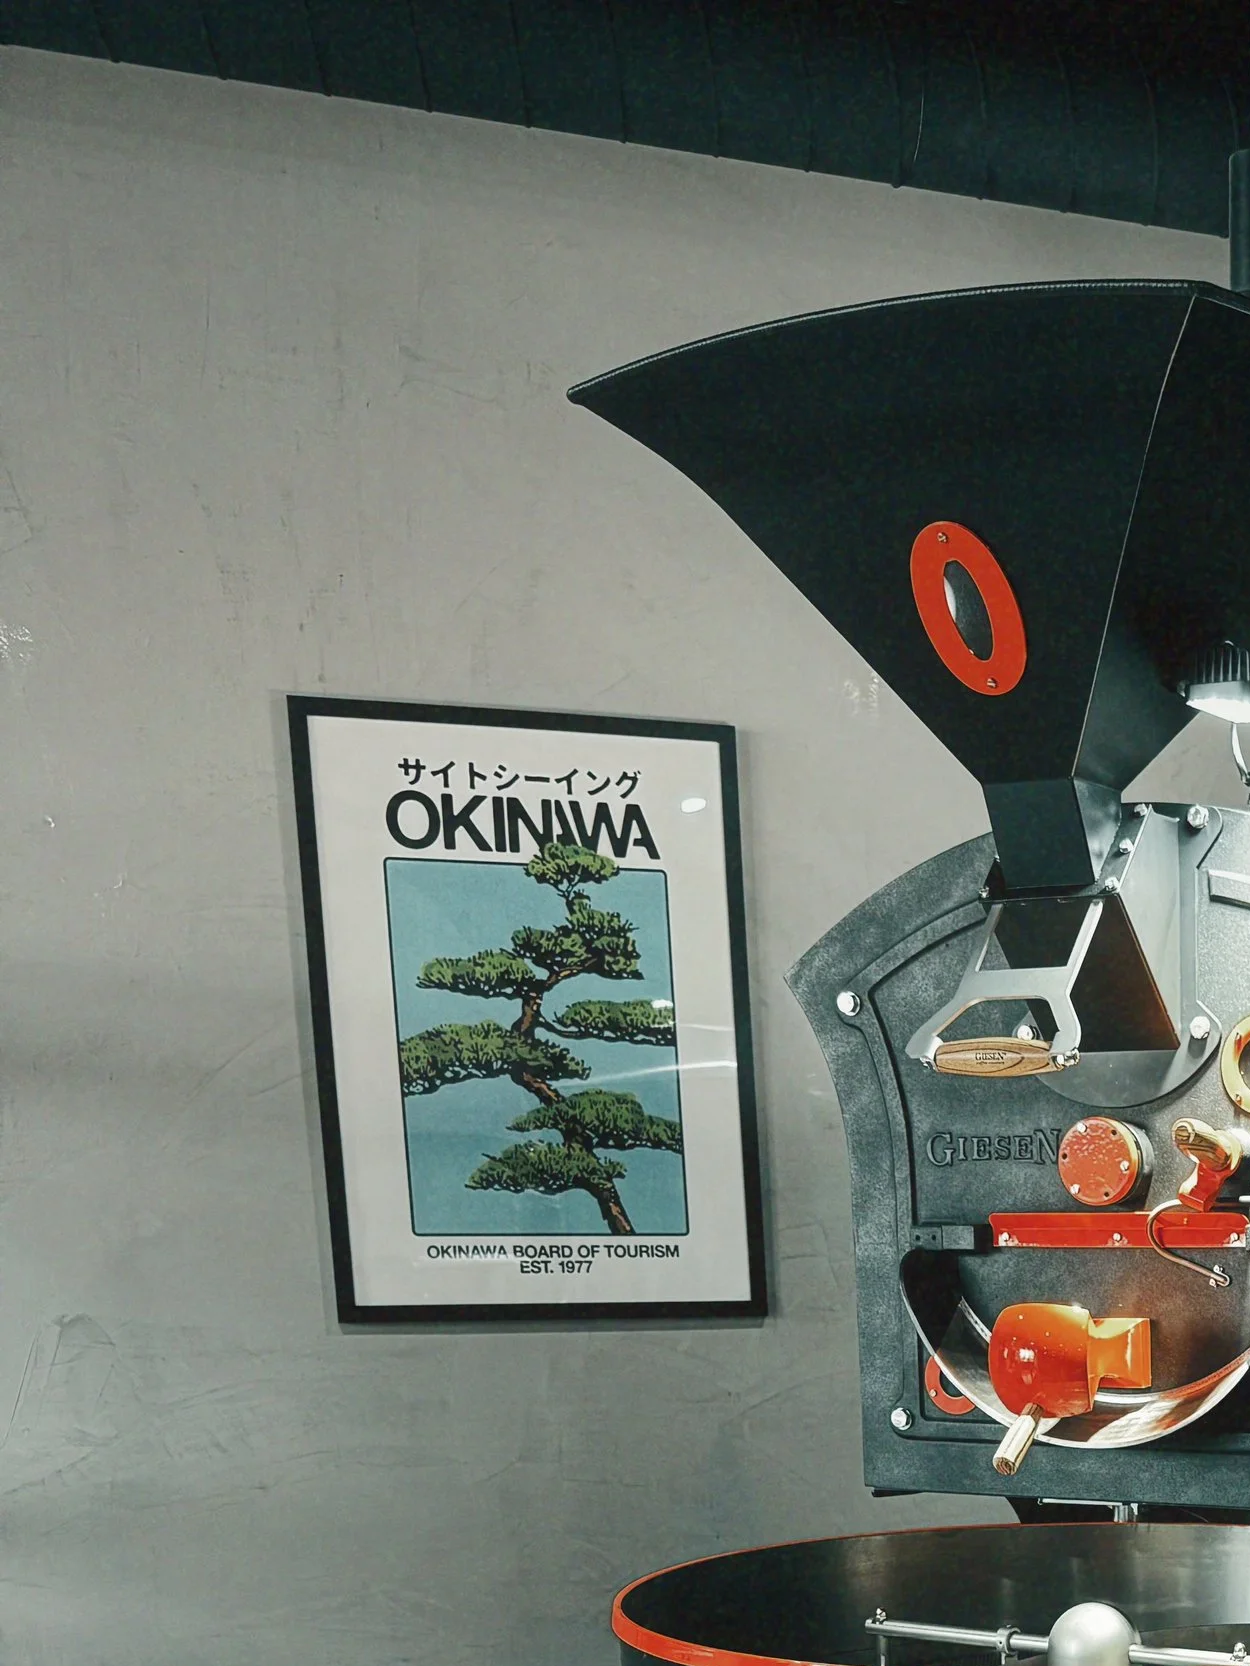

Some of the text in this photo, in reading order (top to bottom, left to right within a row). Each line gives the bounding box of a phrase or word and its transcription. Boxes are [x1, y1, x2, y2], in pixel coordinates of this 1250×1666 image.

[398, 757, 641, 799] サイトシーイング
[385, 789, 661, 860] OKINAWA
[926, 1128, 1061, 1168] GIESEN
[426, 1244, 680, 1259] OKINAWA BOARD OF TOURISM
[519, 1260, 593, 1275] EST. 1977
